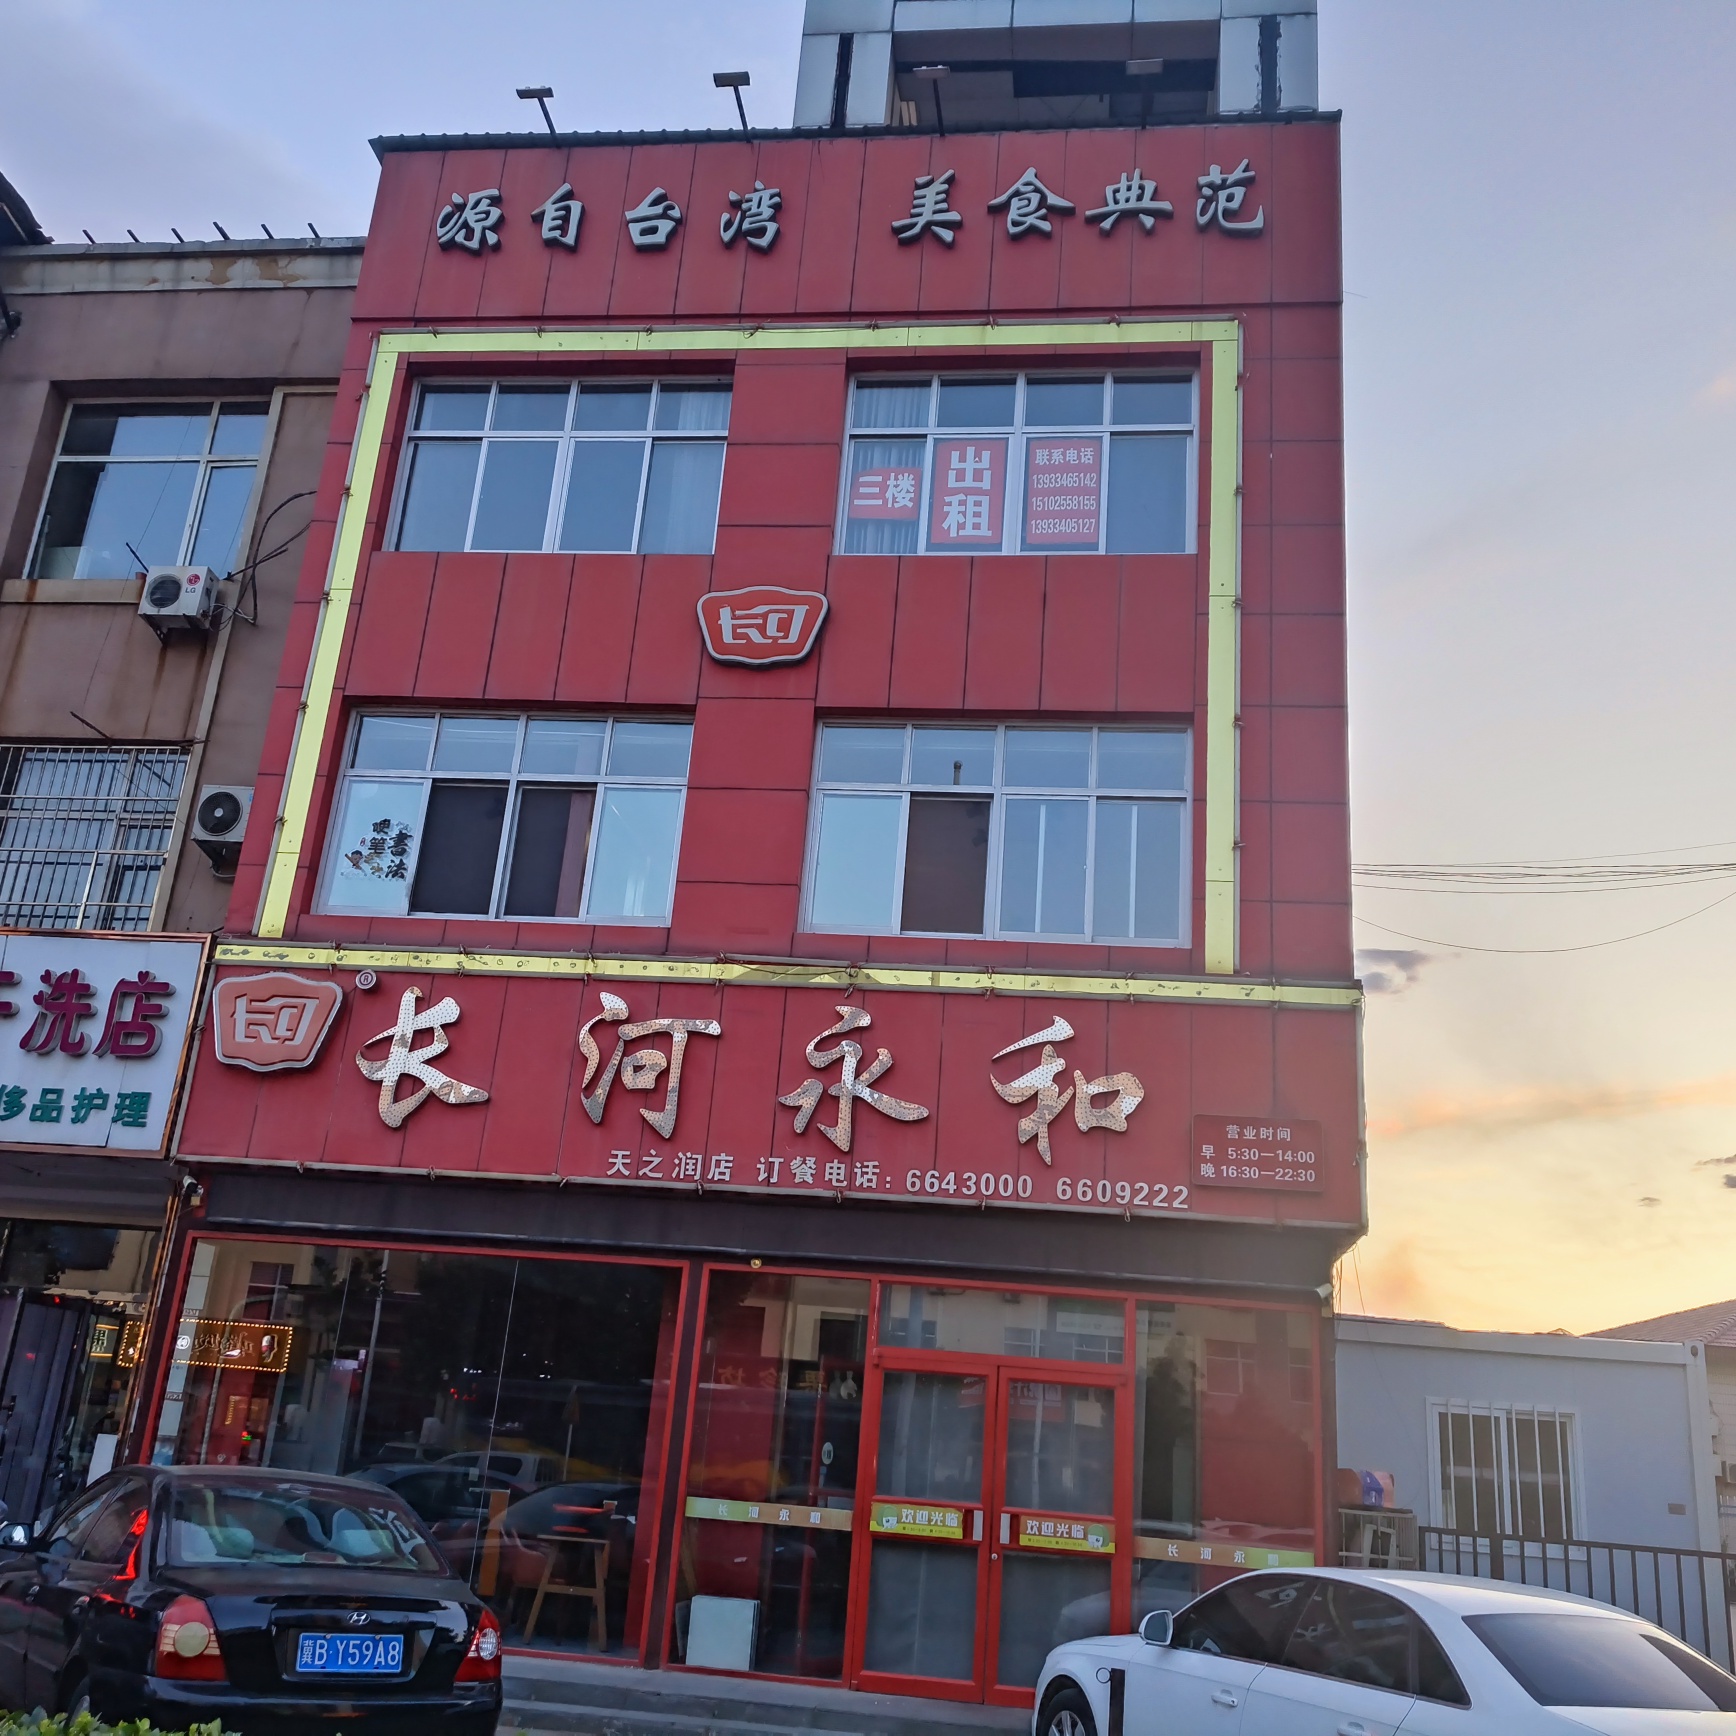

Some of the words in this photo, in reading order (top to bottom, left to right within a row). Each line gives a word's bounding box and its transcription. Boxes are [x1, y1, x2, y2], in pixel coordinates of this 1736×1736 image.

[436, 180, 783, 256] 源自台湾
[891, 159, 1264, 248] 美食典范
[1035, 448, 1095, 466] 联系电话
[853, 472, 915, 508] 三楼
[1032, 472, 1097, 489] 13933465142
[941, 446, 993, 538] 出租
[1031, 495, 1097, 511] 15102558155
[1030, 518, 1096, 534] 13933405127
[355, 986, 1145, 1166] 长河永和
[1226, 1125, 1291, 1141] 营业时间
[1200, 1145, 1216, 1159] 早
[606, 1149, 734, 1182] 天之润店
[1055, 1177, 1189, 1209] 6609222
[1200, 1163, 1216, 1178] 晚
[718, 1503, 821, 1524] 长河永和
[901, 1508, 959, 1527] 欢迎光临
[1026, 1520, 1085, 1539] 欢迎光临
